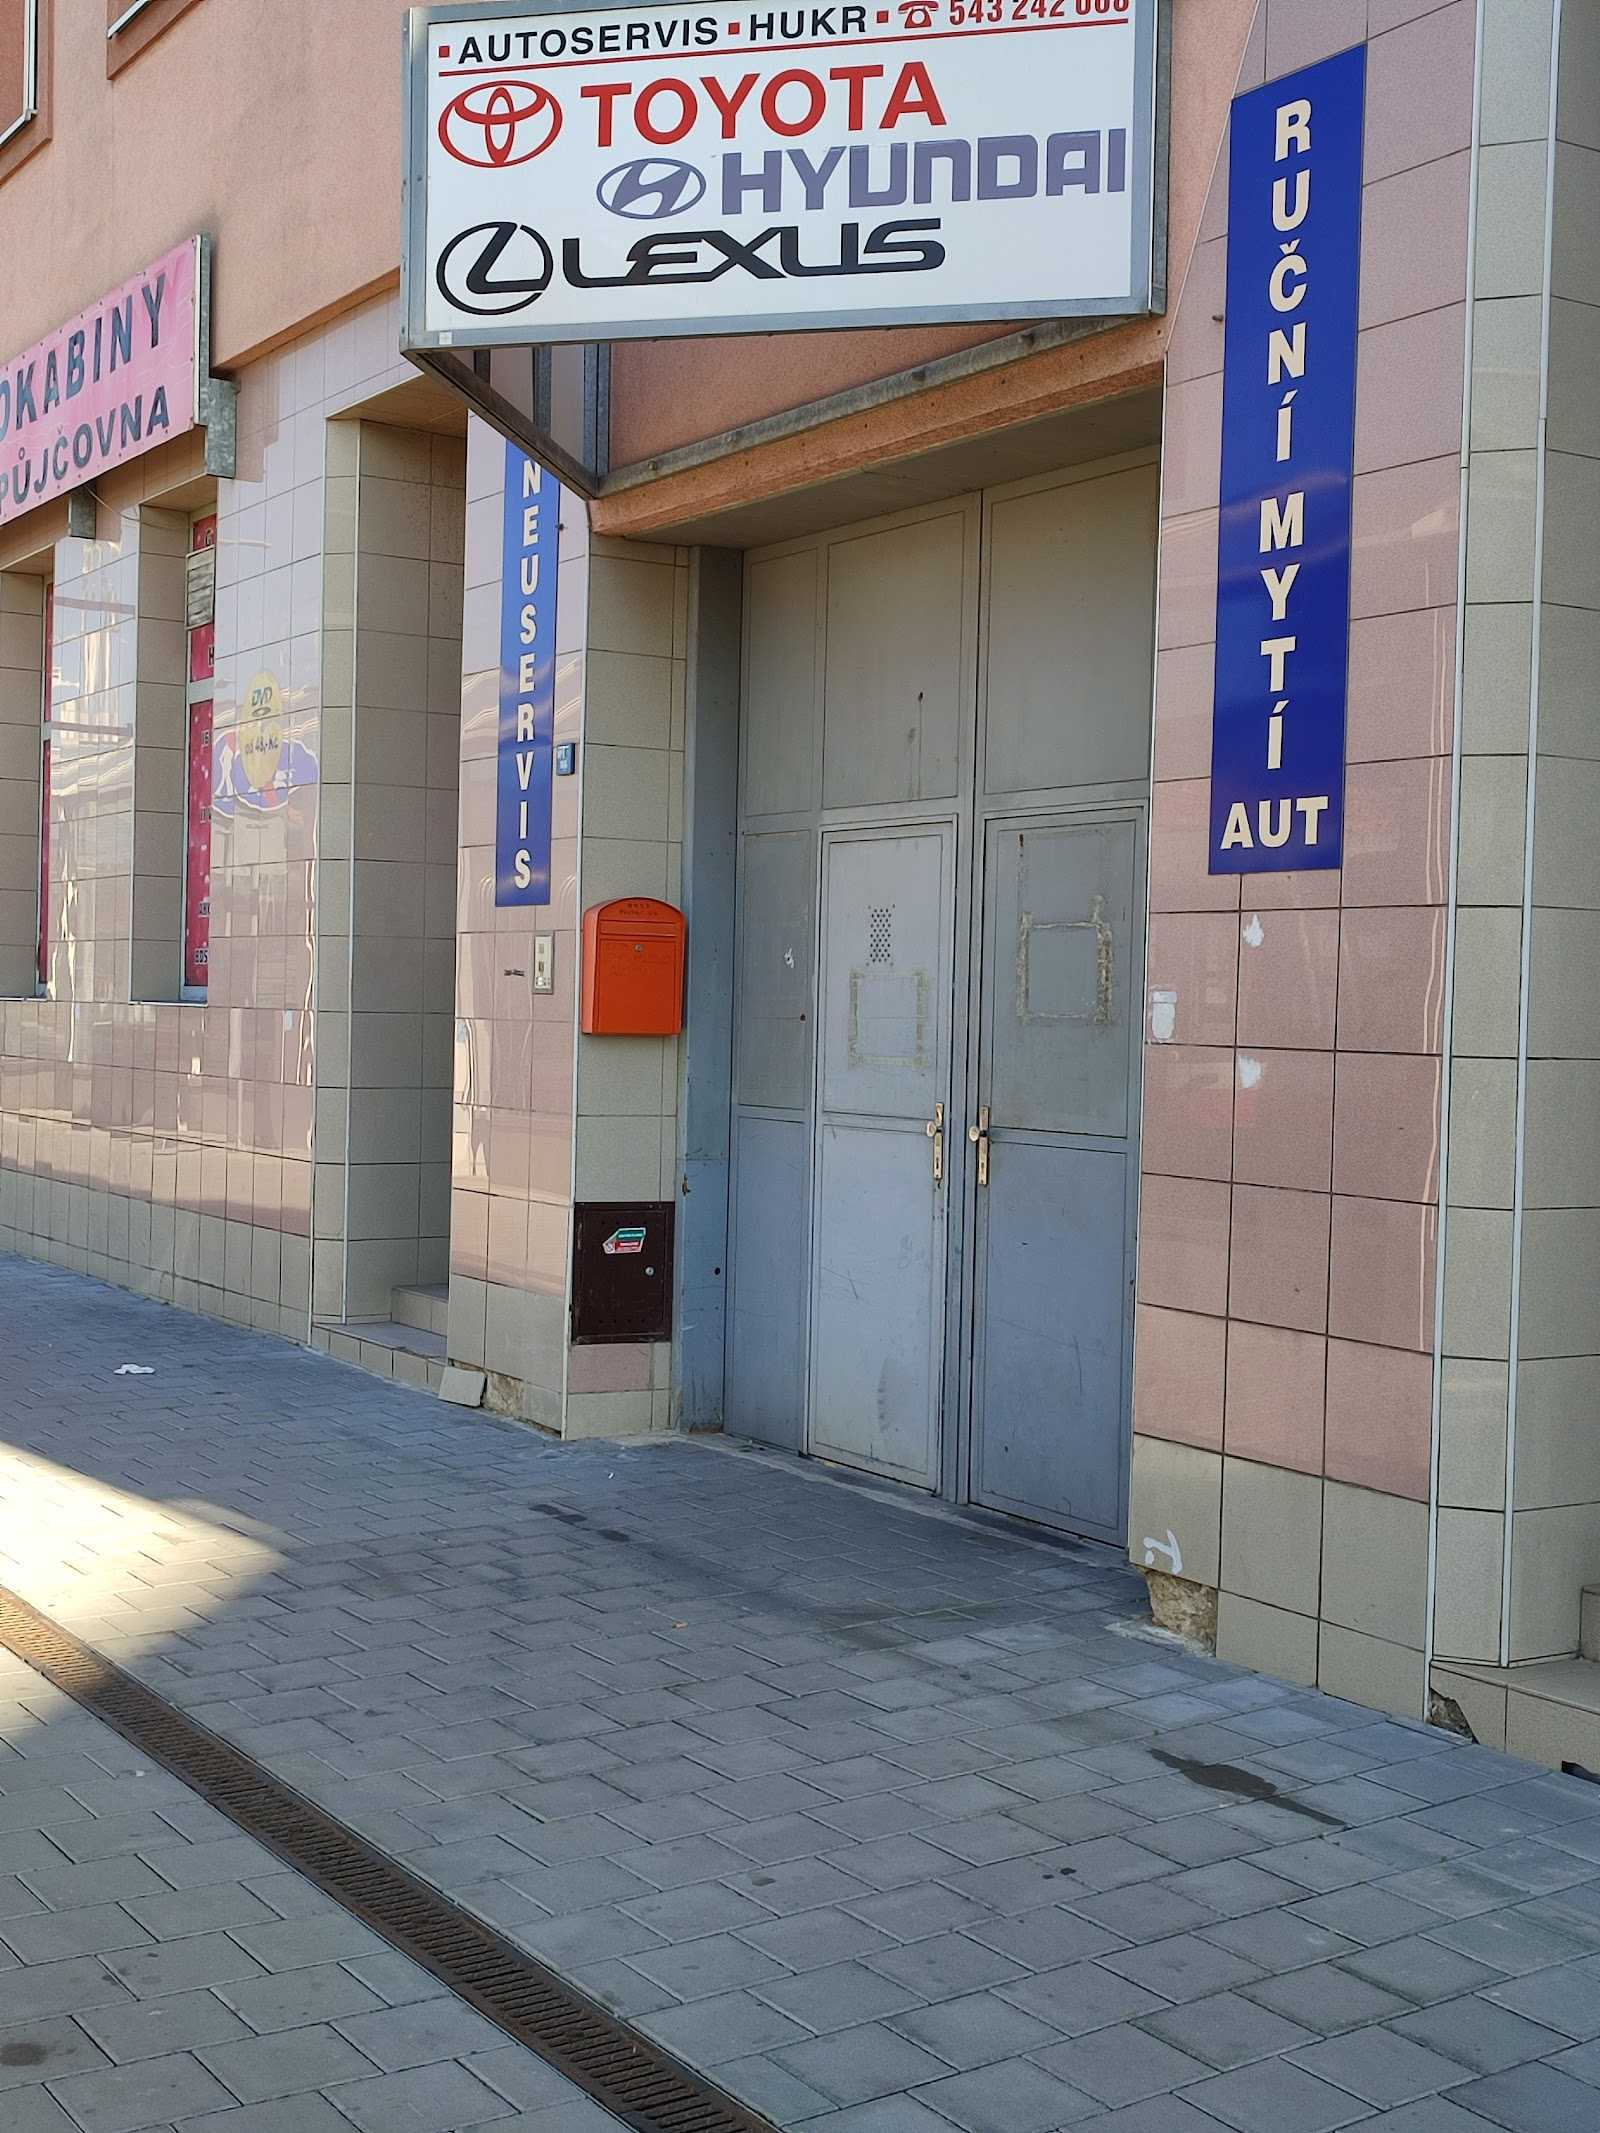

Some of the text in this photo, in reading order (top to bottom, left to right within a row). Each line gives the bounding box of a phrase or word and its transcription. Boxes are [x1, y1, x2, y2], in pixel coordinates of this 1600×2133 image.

[458, 16, 718, 64] AUTOSERVIS
[749, 5, 867, 41] HUKR
[949, 0, 1004, 25] 543
[1012, 0, 1066, 20] 242
[580, 61, 947, 148] TOYOTA
[721, 128, 1128, 215] HYUNDAI
[562, 218, 946, 288] LEXUS
[1259, 98, 1313, 770] RUČNÍ MYTÍ
[513, 458, 542, 890] NEUSERVIS
[1219, 796, 1330, 851] AUT
